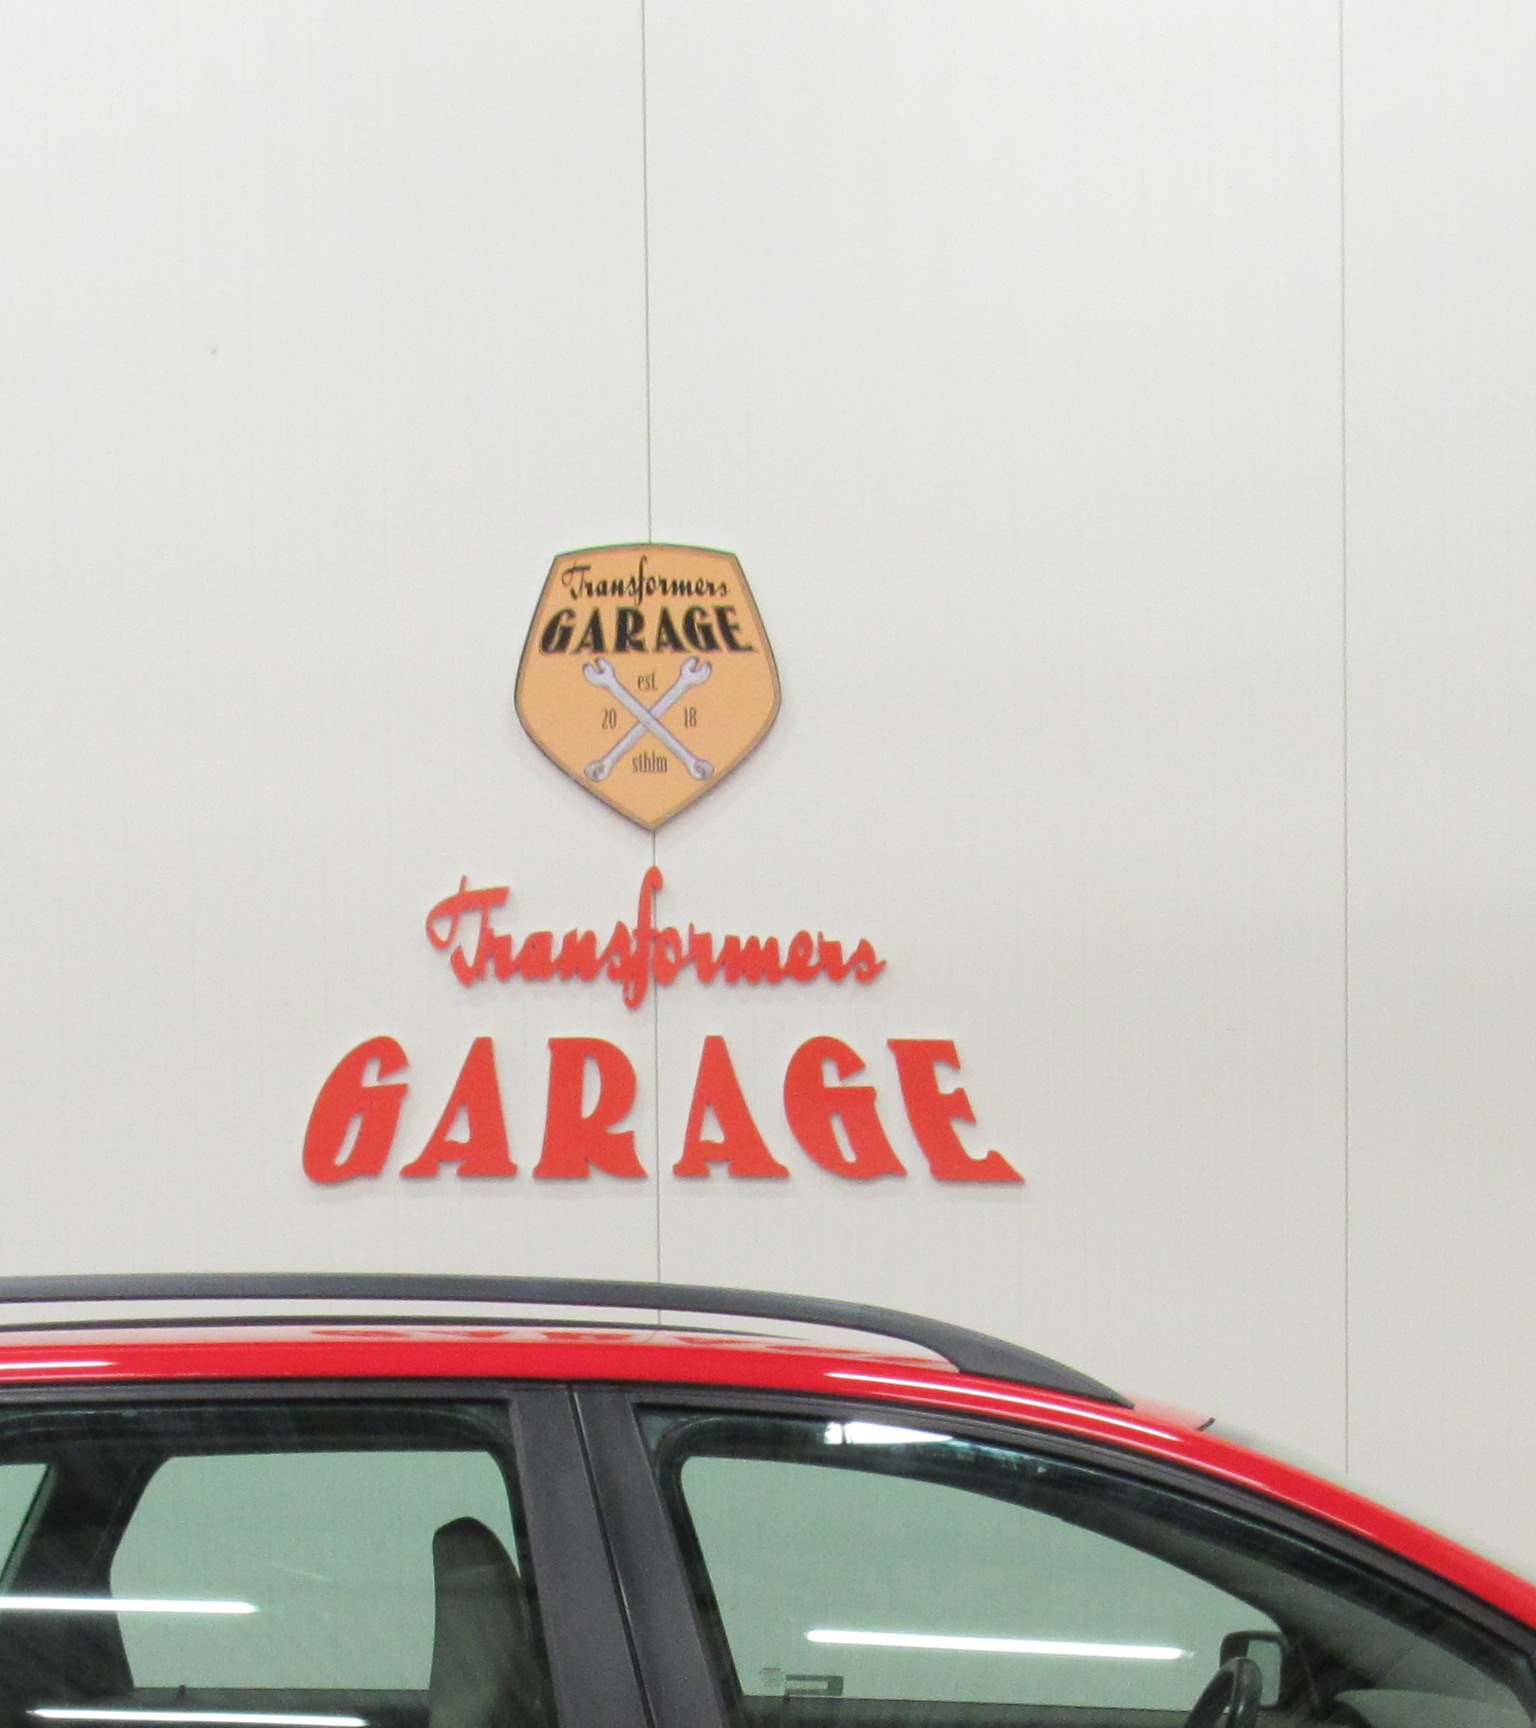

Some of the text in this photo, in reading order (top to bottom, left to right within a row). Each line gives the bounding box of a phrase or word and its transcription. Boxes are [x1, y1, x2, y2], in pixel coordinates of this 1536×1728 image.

[561, 555, 729, 605] Transformers
[538, 605, 757, 654] GARAGE
[601, 707, 697, 730] 20 18
[632, 752, 668, 773] sthlm
[425, 866, 887, 1010] Transformers
[302, 1035, 1025, 1184] GARAGE
